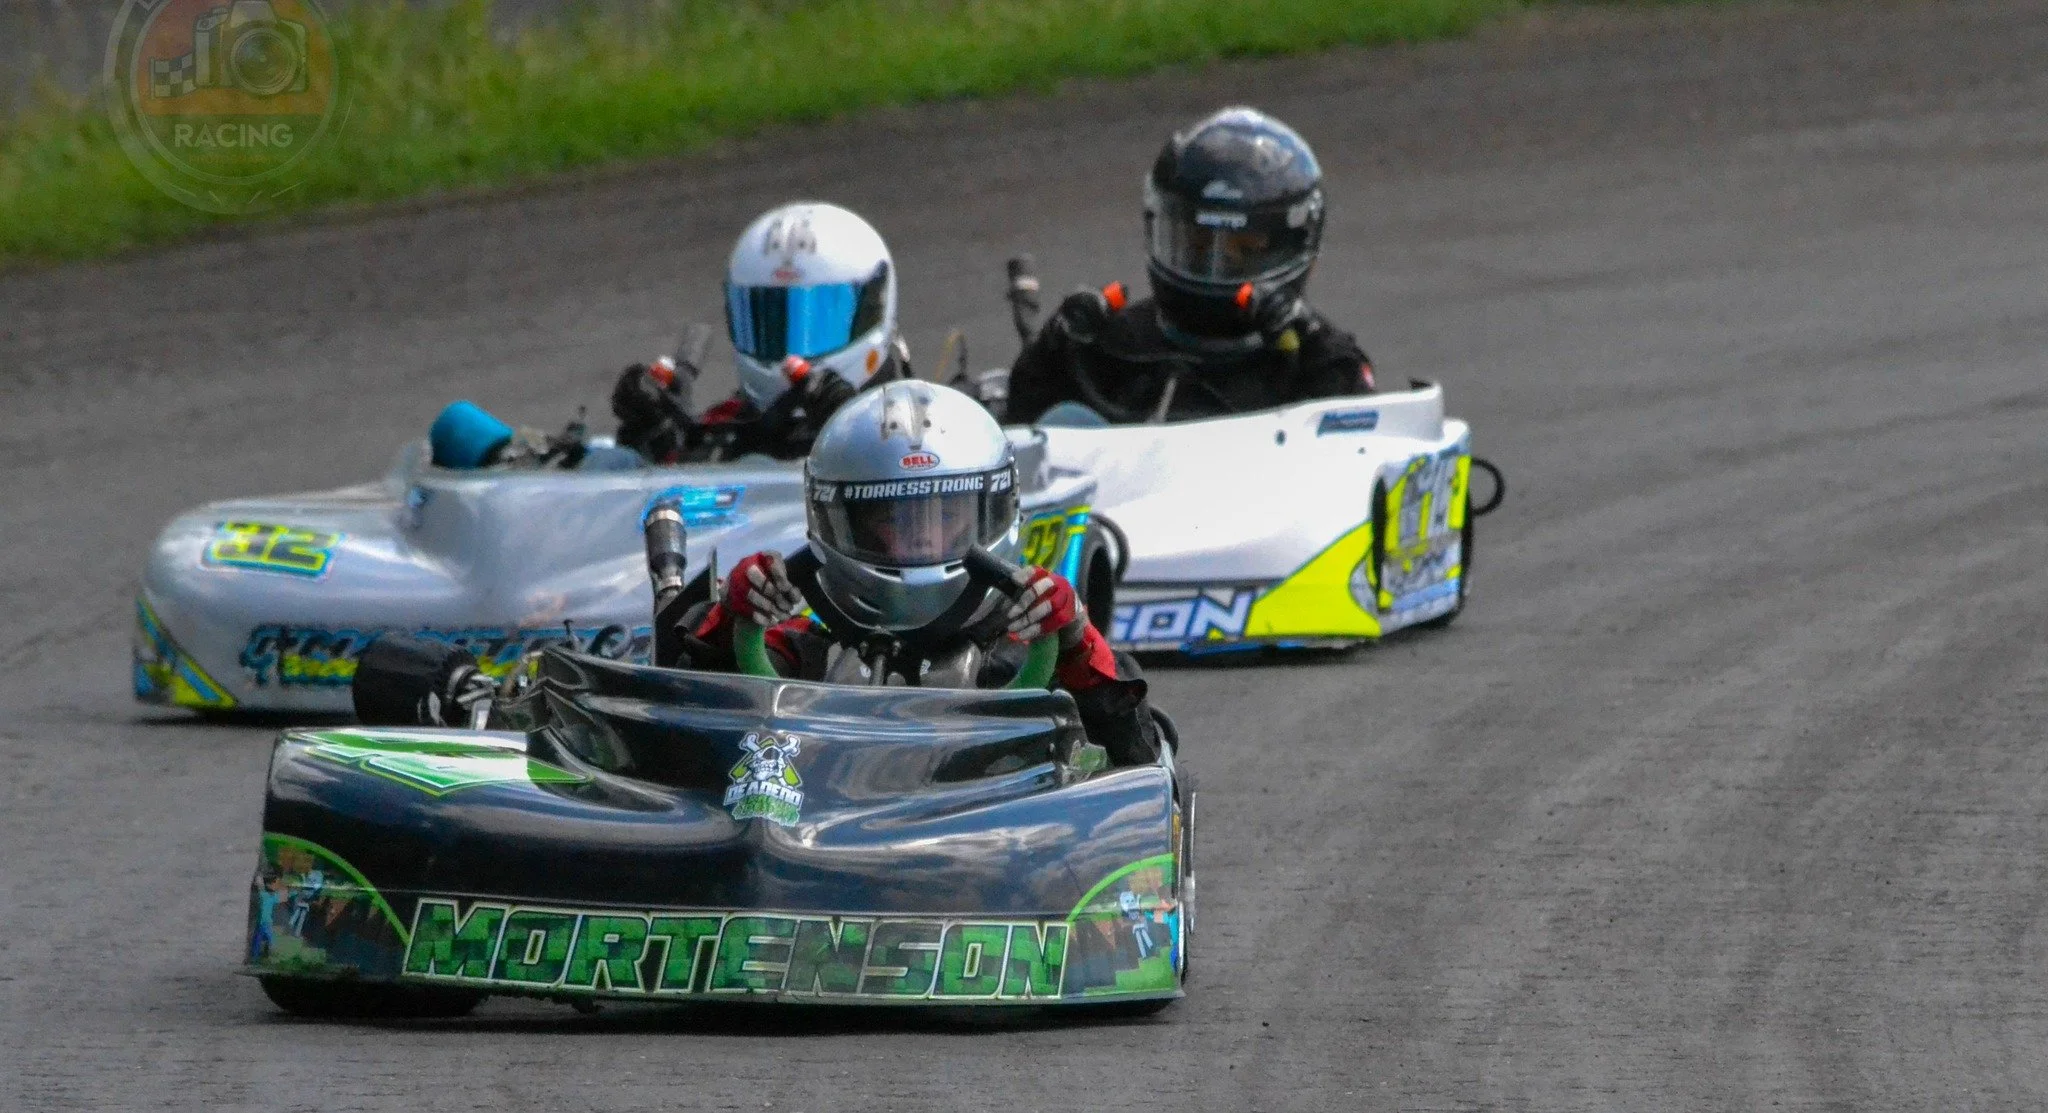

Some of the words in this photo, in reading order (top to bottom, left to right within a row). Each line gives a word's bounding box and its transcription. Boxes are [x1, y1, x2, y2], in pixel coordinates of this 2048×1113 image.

[902, 455, 934, 466] BELL
[813, 483, 837, 503] 721
[844, 472, 984, 500] #TORRESSTRONG
[990, 467, 1012, 493] 721
[402, 897, 1070, 1001] MORTENSON
